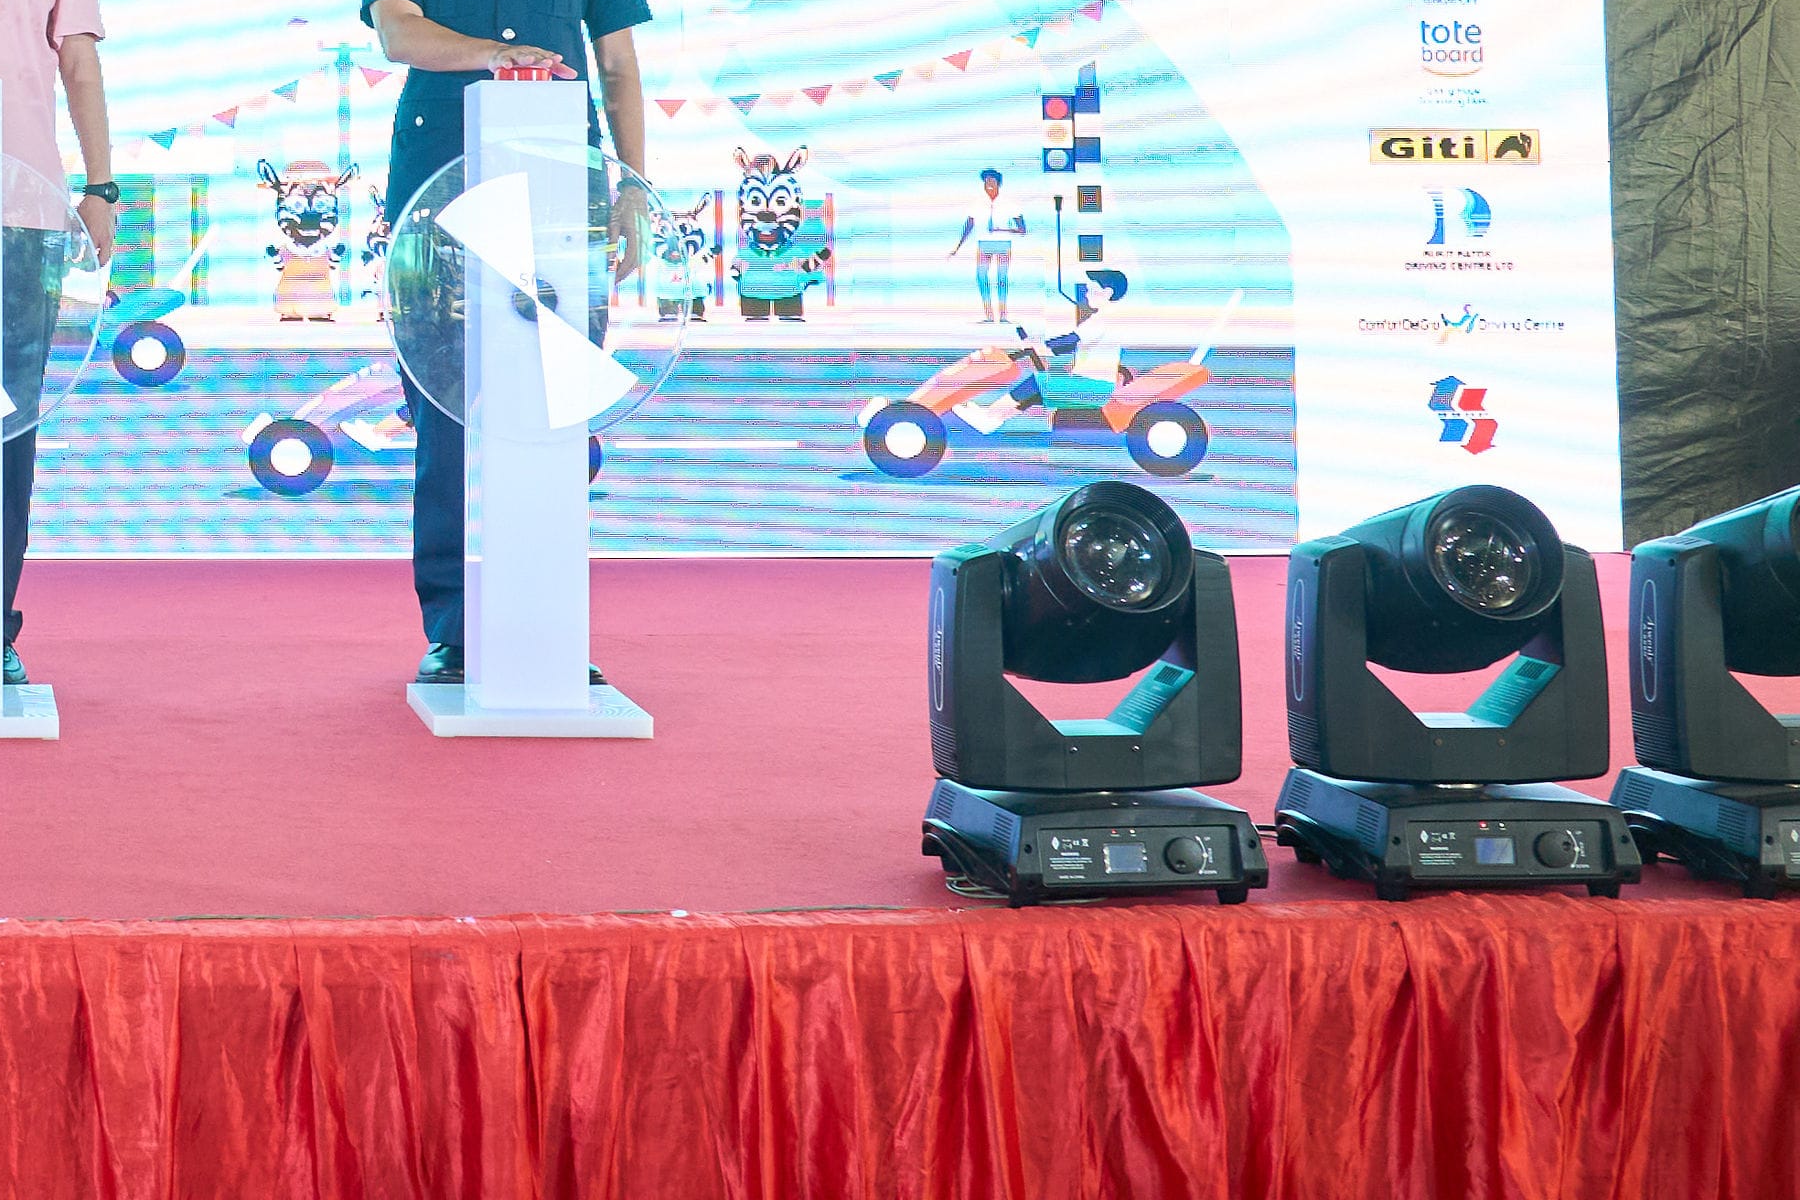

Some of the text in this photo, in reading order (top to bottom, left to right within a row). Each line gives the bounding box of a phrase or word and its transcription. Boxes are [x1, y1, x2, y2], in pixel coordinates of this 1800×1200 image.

[1420, 20, 1482, 45] tote
[1422, 47, 1484, 63] board
[1381, 136, 1474, 159] Giti
